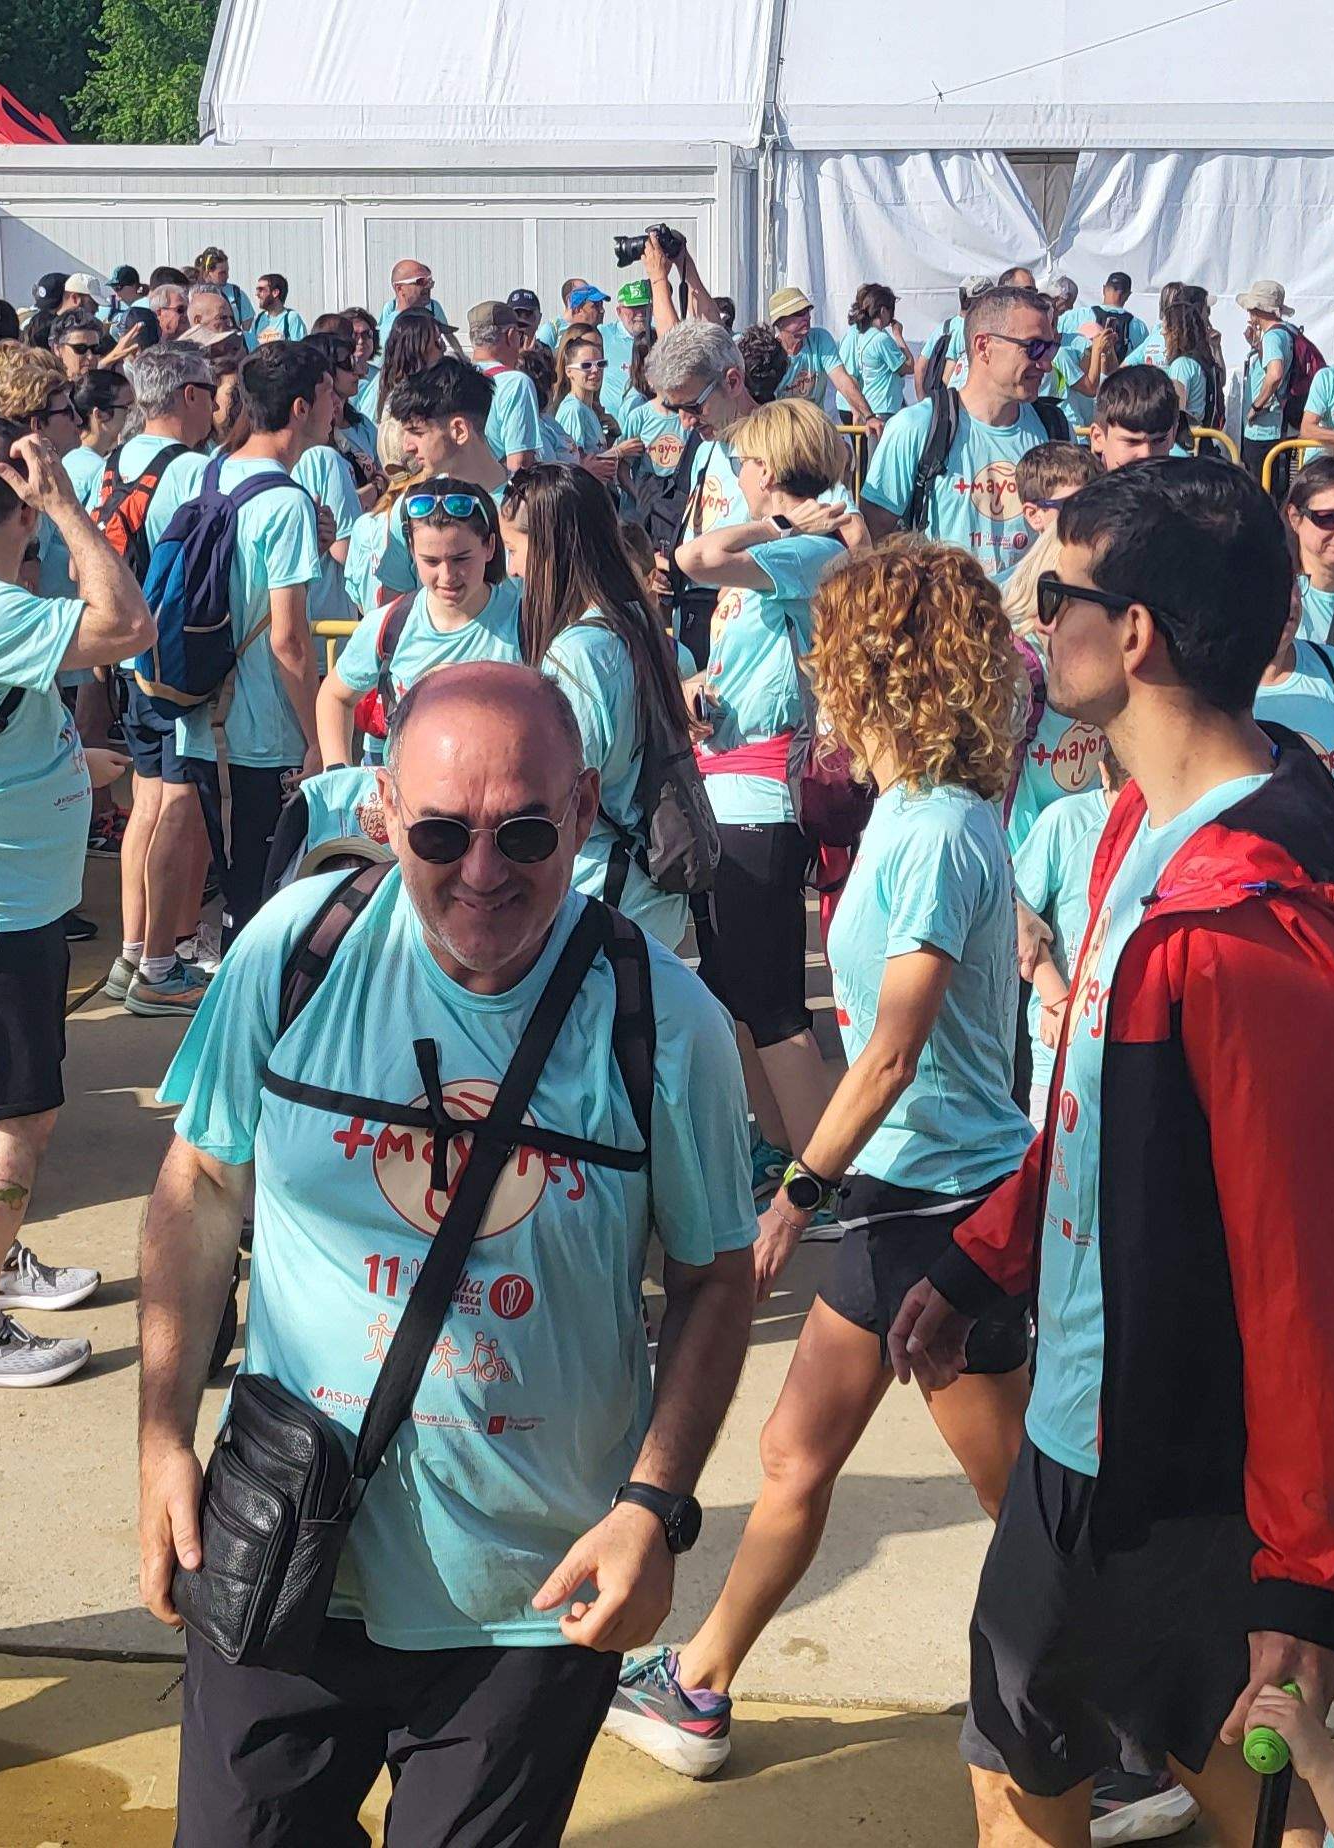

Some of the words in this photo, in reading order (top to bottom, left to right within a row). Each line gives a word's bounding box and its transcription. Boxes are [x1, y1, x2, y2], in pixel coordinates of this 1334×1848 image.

[953, 477, 1017, 507] +mayo
[1030, 734, 1109, 774] +mayor
[452, 1294, 482, 1306] UESCA
